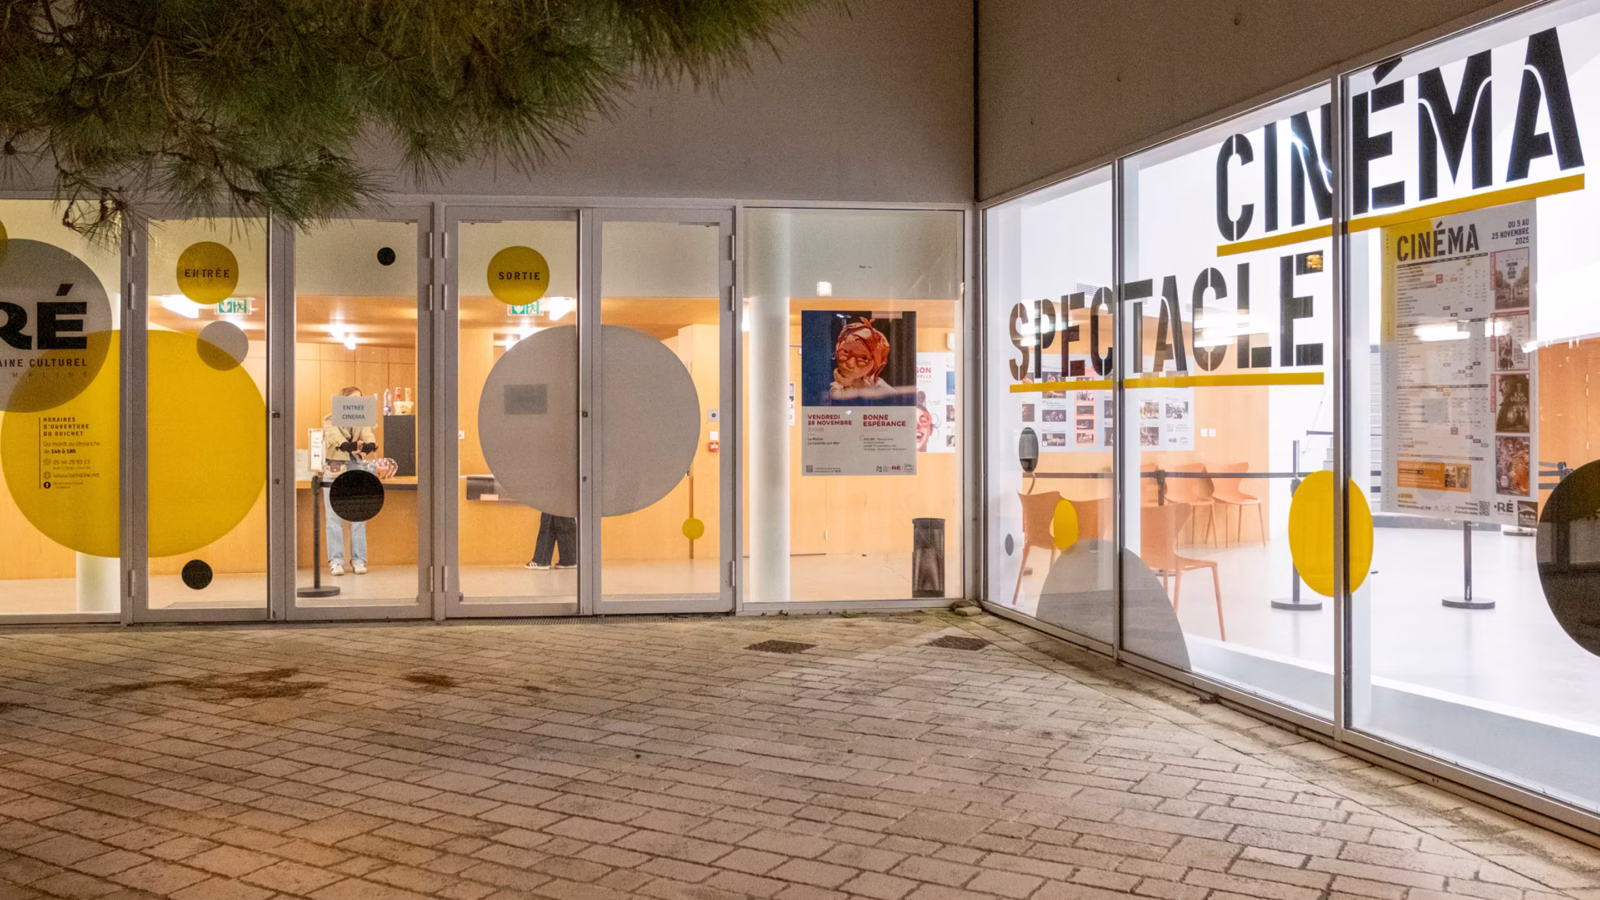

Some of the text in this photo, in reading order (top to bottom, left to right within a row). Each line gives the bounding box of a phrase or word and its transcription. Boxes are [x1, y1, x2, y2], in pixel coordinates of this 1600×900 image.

[1216, 27, 1585, 242] CINÉMA
[1508, 218, 1530, 229] DU 5 AU
[1491, 227, 1530, 240] 25 NOVEMBRE
[1397, 220, 1480, 262] CINÉMA
[1515, 236, 1530, 245] 2025
[184, 266, 230, 278] ENTRÉE
[498, 271, 541, 280] SORTIE
[1009, 250, 1324, 382] SPECTACLE
[29, 358, 87, 367] CULTUREL
